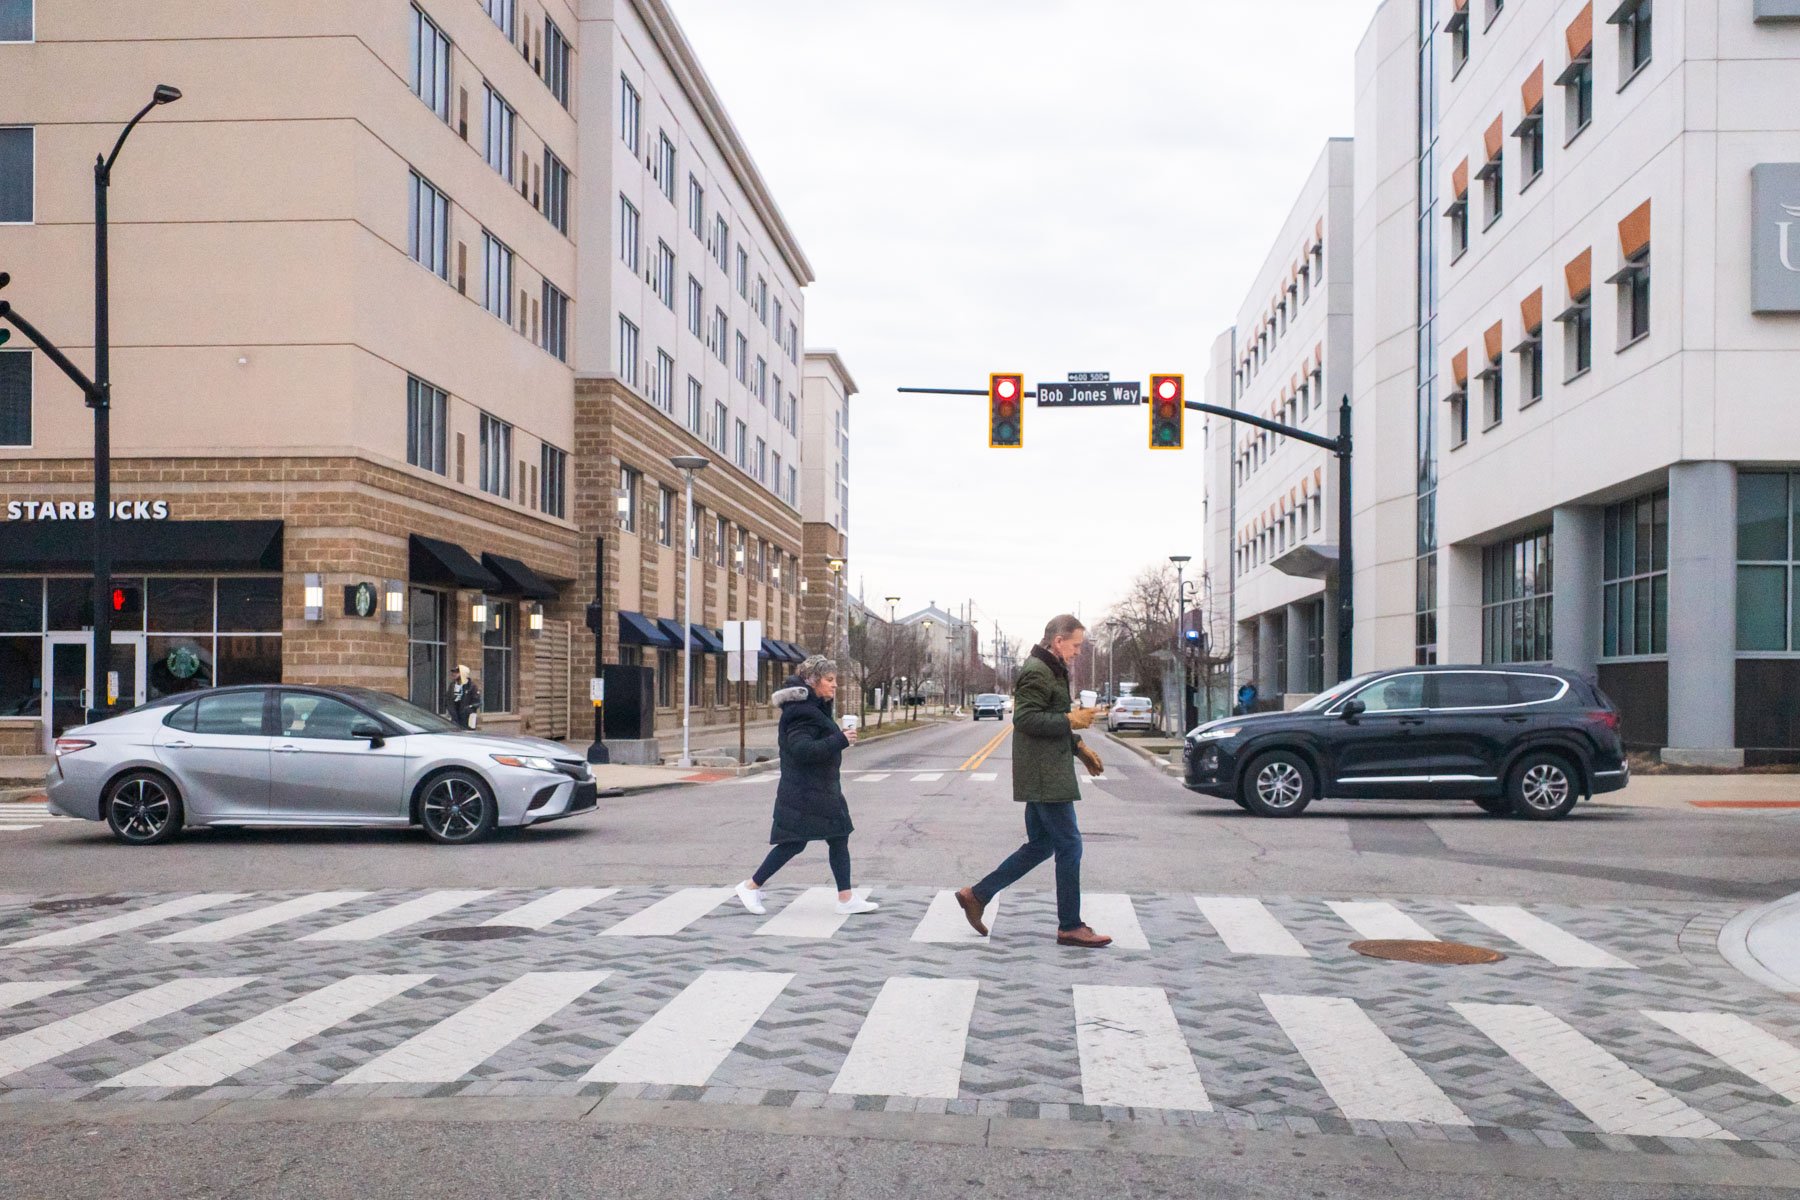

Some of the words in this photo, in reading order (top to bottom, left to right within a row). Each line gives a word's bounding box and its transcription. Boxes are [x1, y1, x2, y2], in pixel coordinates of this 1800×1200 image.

[1040, 388, 1063, 402] Bob
[1069, 388, 1107, 402] Jones
[1113, 387, 1138, 404] Way
[7, 500, 168, 520] STARBCKS
